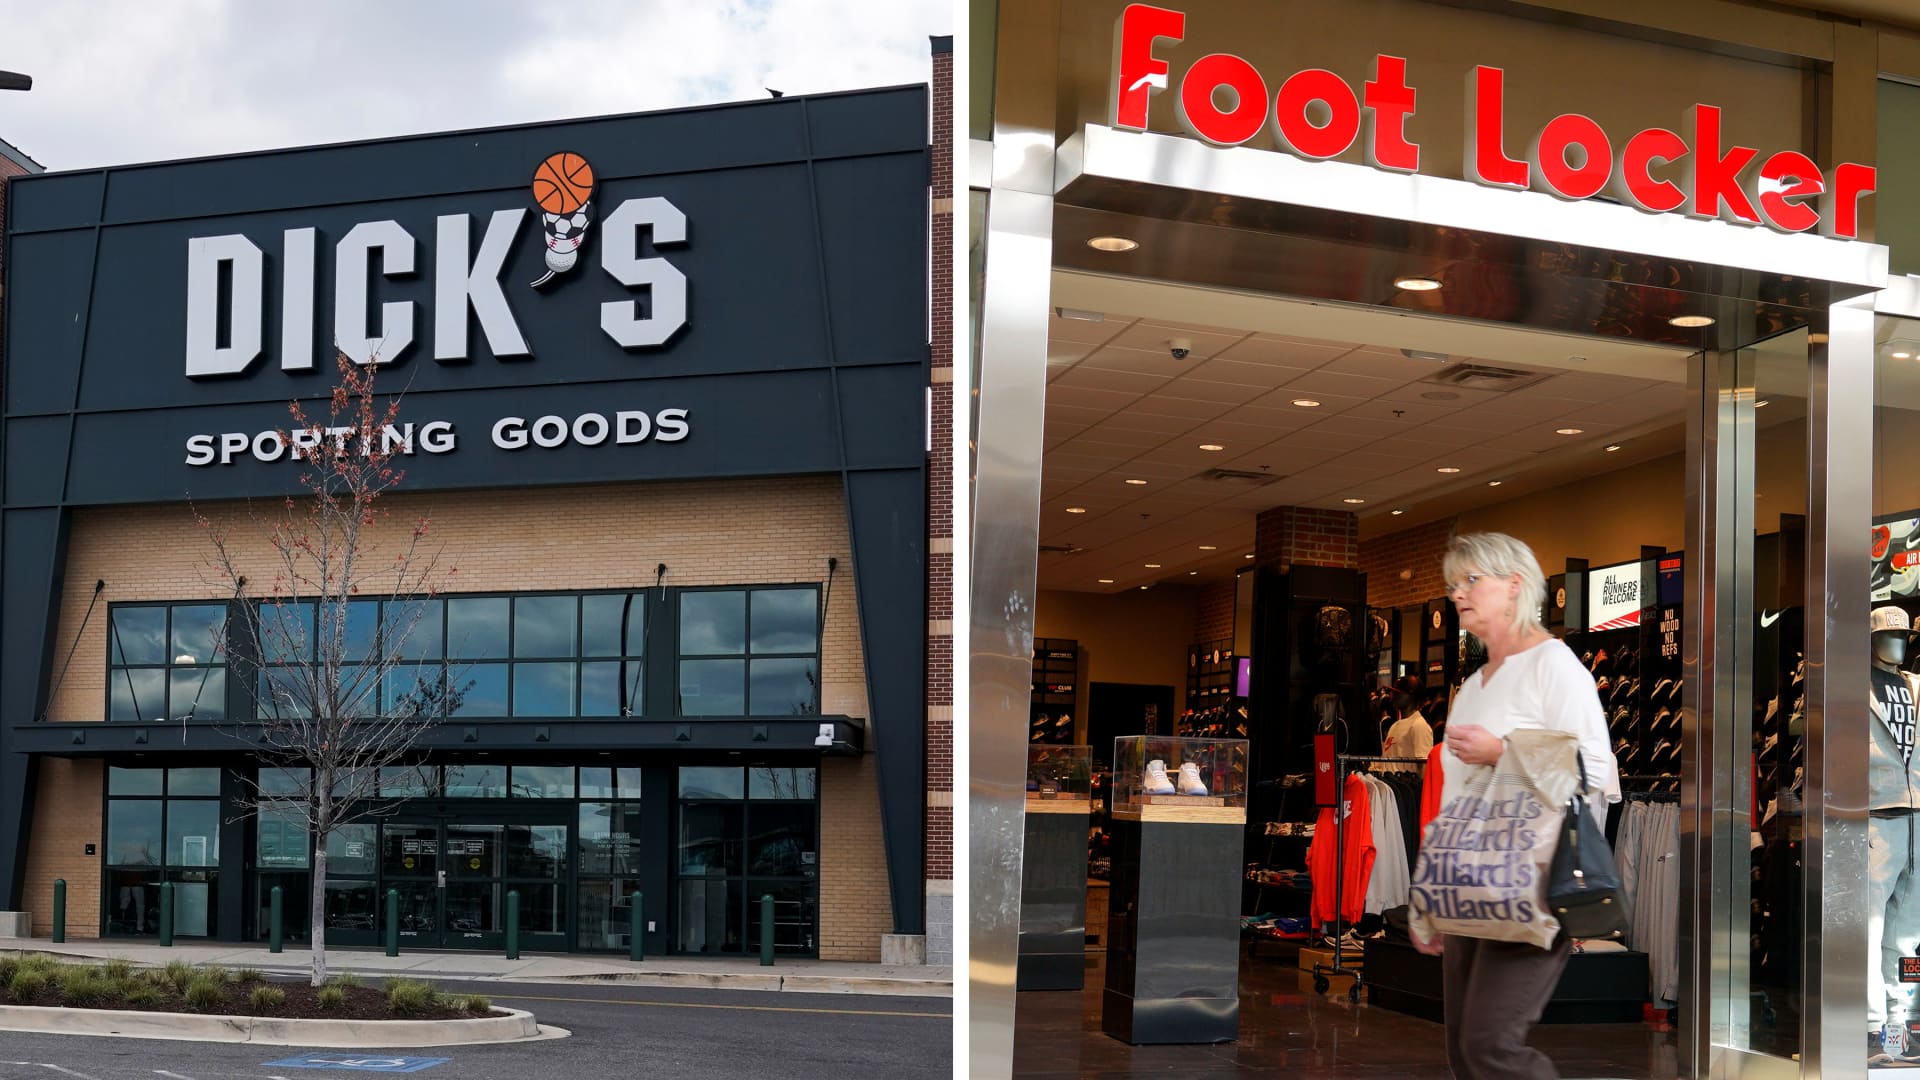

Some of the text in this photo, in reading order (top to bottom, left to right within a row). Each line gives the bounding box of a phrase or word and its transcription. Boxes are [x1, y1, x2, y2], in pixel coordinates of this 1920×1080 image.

[1112, 3, 1878, 239] Foot Locker
[186, 165, 690, 377] DICK'S
[492, 409, 690, 450] GOODS
[1906, 552, 1918, 565] AIR
[1605, 574, 1616, 585] ALL
[1604, 581, 1637, 596] RUNNERS
[1603, 591, 1636, 605] WELCOME
[1664, 609, 1674, 621] NO
[1660, 619, 1679, 633] WOOD
[1664, 631, 1674, 644] NO
[1661, 643, 1678, 657] REFS
[1885, 685, 1912, 705] NO
[1441, 791, 1542, 821] illard's
